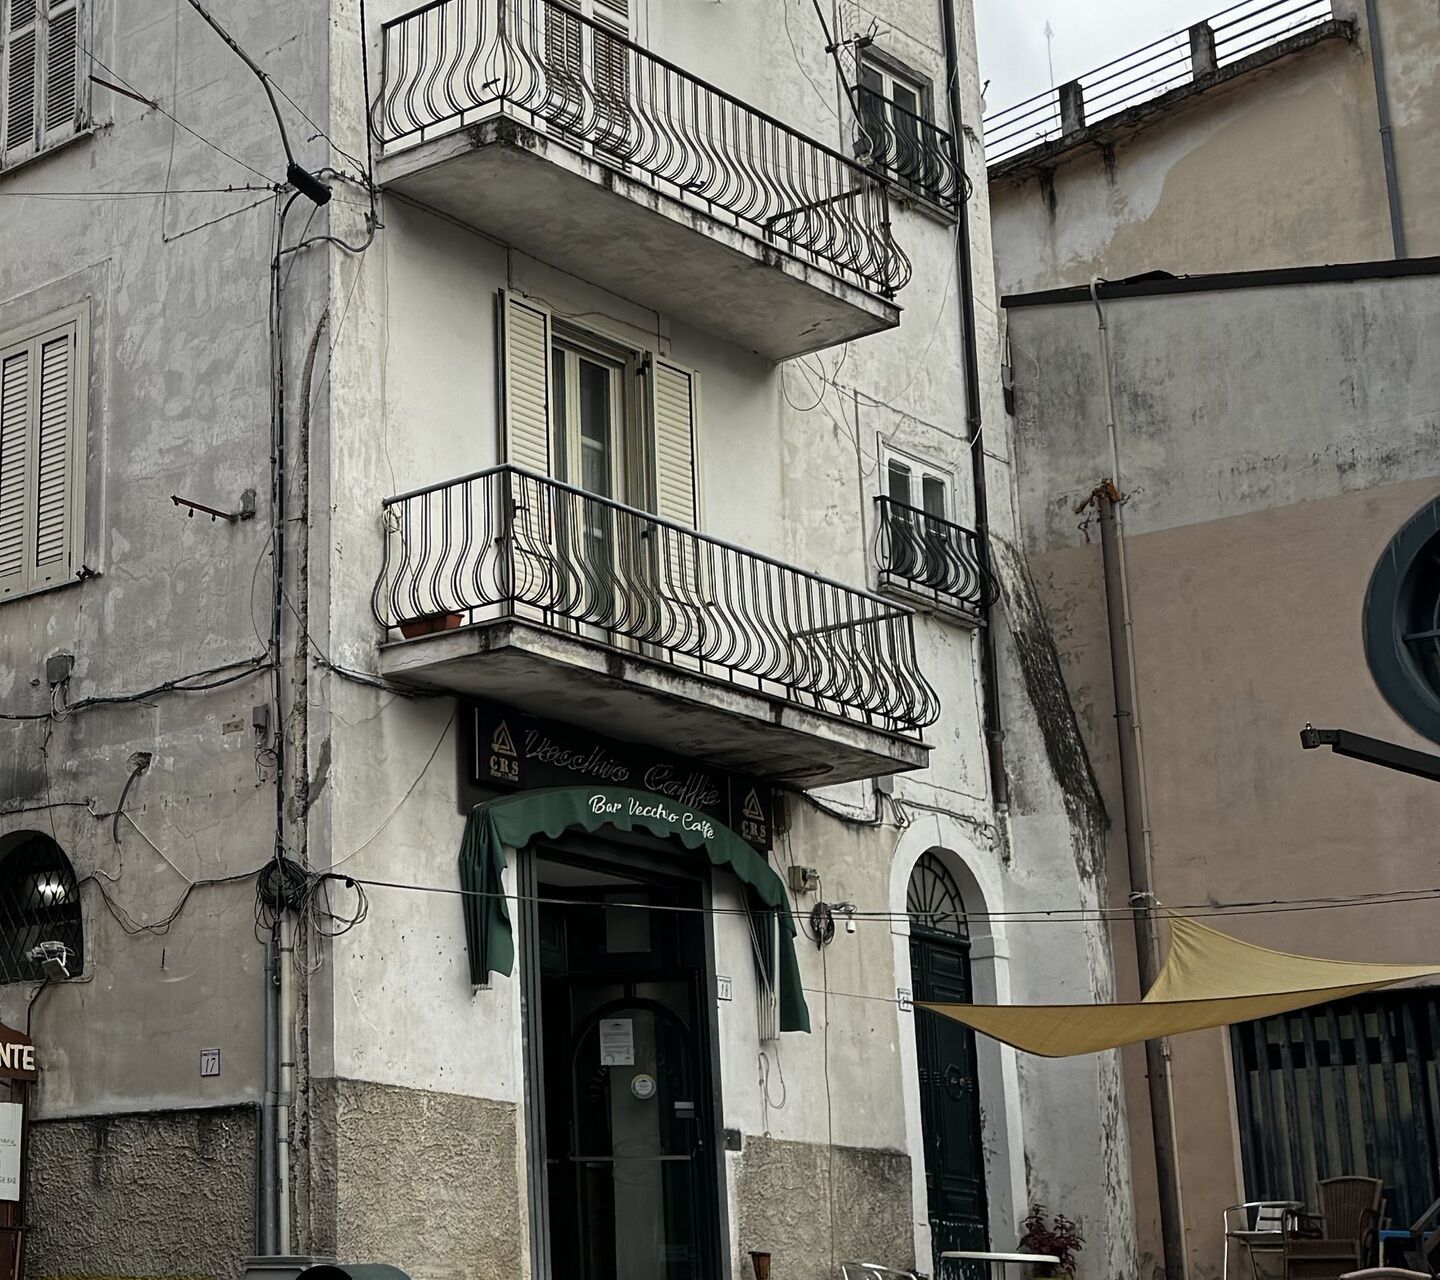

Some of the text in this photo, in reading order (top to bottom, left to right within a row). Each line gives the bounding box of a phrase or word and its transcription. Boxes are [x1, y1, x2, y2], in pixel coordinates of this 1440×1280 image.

[489, 755, 519, 775] CRS
[525, 729, 630, 781] Vecchio
[589, 794, 622, 814] Bar
[628, 797, 679, 823] Vecchio
[741, 820, 767, 838] CRS
[205, 1057, 216, 1073] 17
